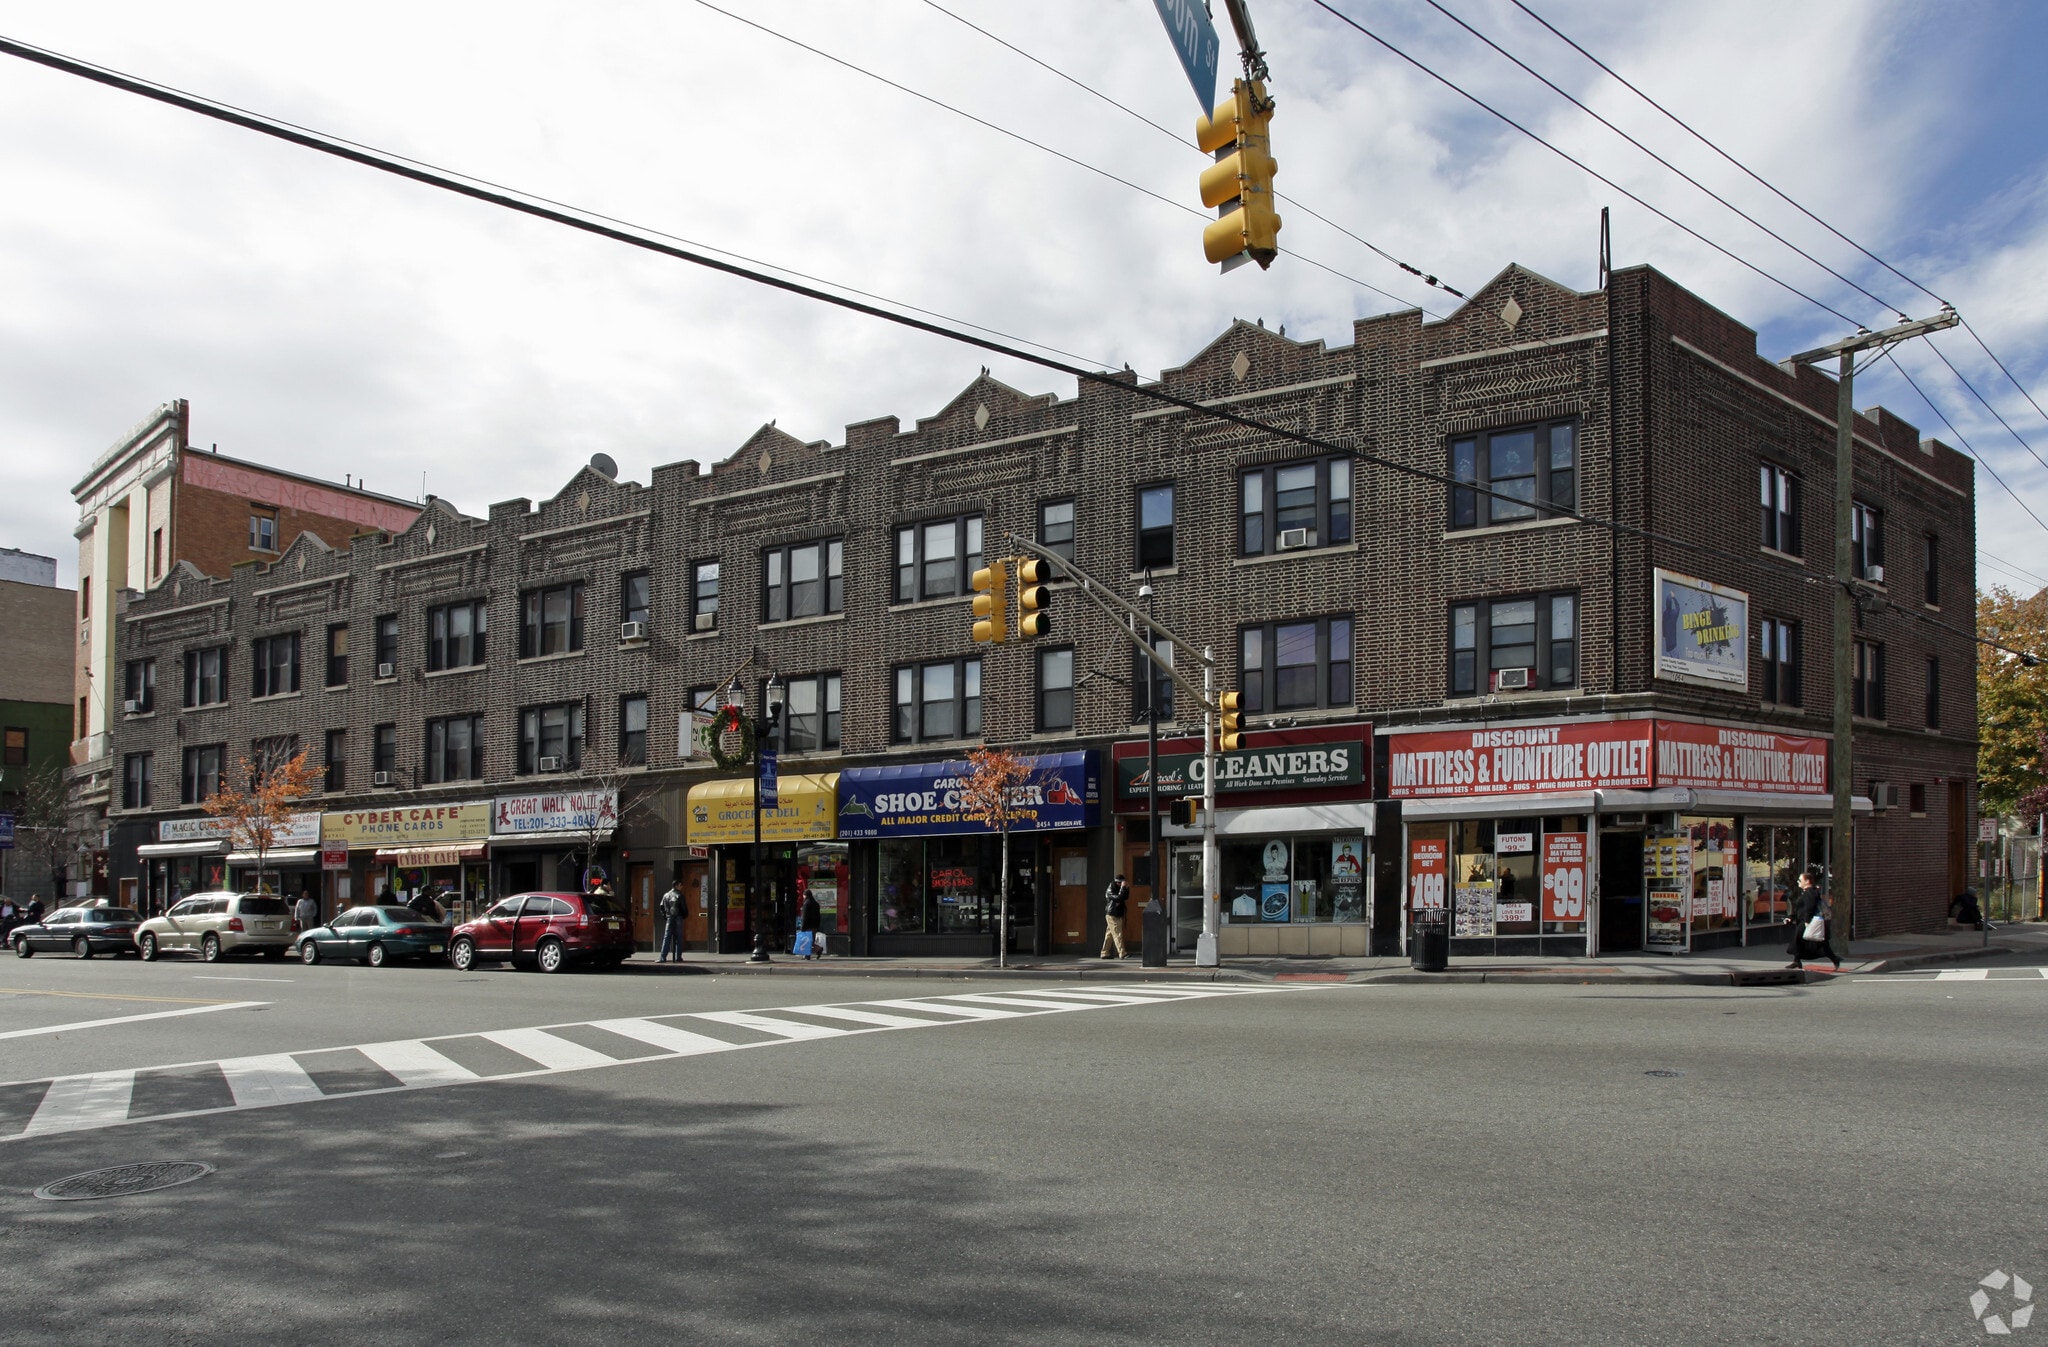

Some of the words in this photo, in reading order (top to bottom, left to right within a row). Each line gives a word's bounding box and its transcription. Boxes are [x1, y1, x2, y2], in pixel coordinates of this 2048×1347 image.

[1205, 39, 1215, 76] St
[1682, 611, 1712, 629] BINGE
[1696, 624, 1740, 645] DRINKING
[1472, 727, 1560, 748] DISCOUNT
[1718, 729, 1776, 749] DISCOUNT
[1188, 748, 1349, 781] CLEANERS
[1392, 749, 1475, 787] MATTRESS
[1478, 754, 1490, 783] &
[1493, 743, 1583, 782] FURNITURE
[1587, 739, 1650, 778] OUTLET
[1658, 740, 1721, 779] MATTRESS
[1724, 751, 1732, 779] &
[1734, 747, 1790, 782] FURNITURE
[1792, 752, 1825, 784] OUTLET
[1271, 777, 1295, 785] Premises
[1302, 775, 1327, 784] Sameday
[1327, 774, 1348, 782] Service
[1436, 786, 1453, 794] ROOM
[1513, 783, 1530, 791] RUGS
[1536, 782, 1556, 790] LIVING
[1576, 780, 1592, 788] SETS
[1598, 779, 1610, 787] BED
[1611, 778, 1630, 786] ROOM
[1658, 777, 1673, 785] SOFAS
[511, 797, 538, 815] GREAT
[542, 796, 565, 813] WALL
[875, 791, 937, 813] SHOE
[343, 810, 403, 826] CYBER
[765, 810, 774, 818] &
[777, 808, 799, 818] DELI
[881, 817, 894, 825] ALL
[897, 815, 927, 824] MAJOR
[930, 813, 960, 823] CREDIT
[172, 822, 196, 832] MAGIC
[361, 822, 399, 833] PHONE
[404, 820, 444, 831] CARDS
[1054, 820, 1072, 828] BERGEN
[839, 829, 852, 837] (201)
[399, 852, 430, 866] CYBER
[434, 851, 458, 864] CAFE
[931, 868, 966, 879] CAROL
[931, 879, 951, 887] SHOES
[957, 877, 974, 886] BAGS
[1411, 873, 1444, 909] $499
[1544, 867, 1583, 917] $99
